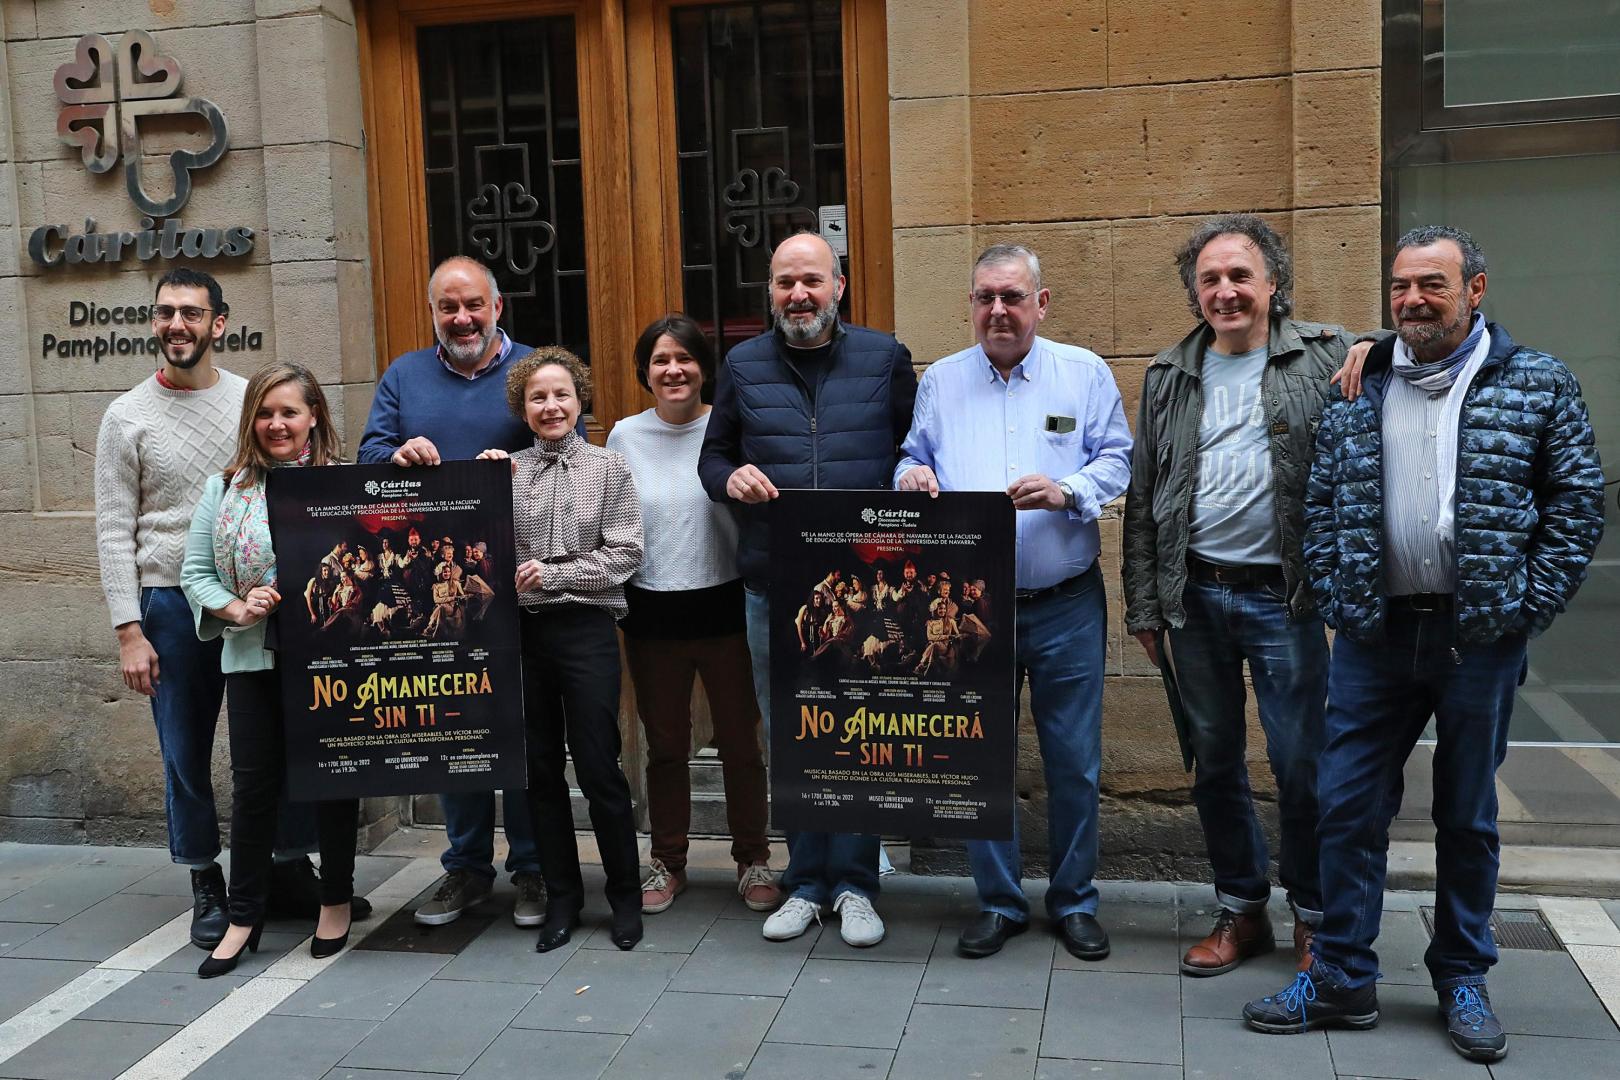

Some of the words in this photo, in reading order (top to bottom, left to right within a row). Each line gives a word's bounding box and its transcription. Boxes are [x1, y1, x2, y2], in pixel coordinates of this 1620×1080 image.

[28, 216, 255, 266] Cáritas
[380, 480, 422, 489] Cáritas
[878, 509, 920, 518] Cáritas
[354, 668, 492, 710] AMANECERÁ
[374, 706, 406, 728] SIN
[416, 704, 436, 726] TI
[840, 706, 984, 744] AMANECERÁ
[860, 742, 893, 765] SIN
[903, 744, 923, 767] TI
